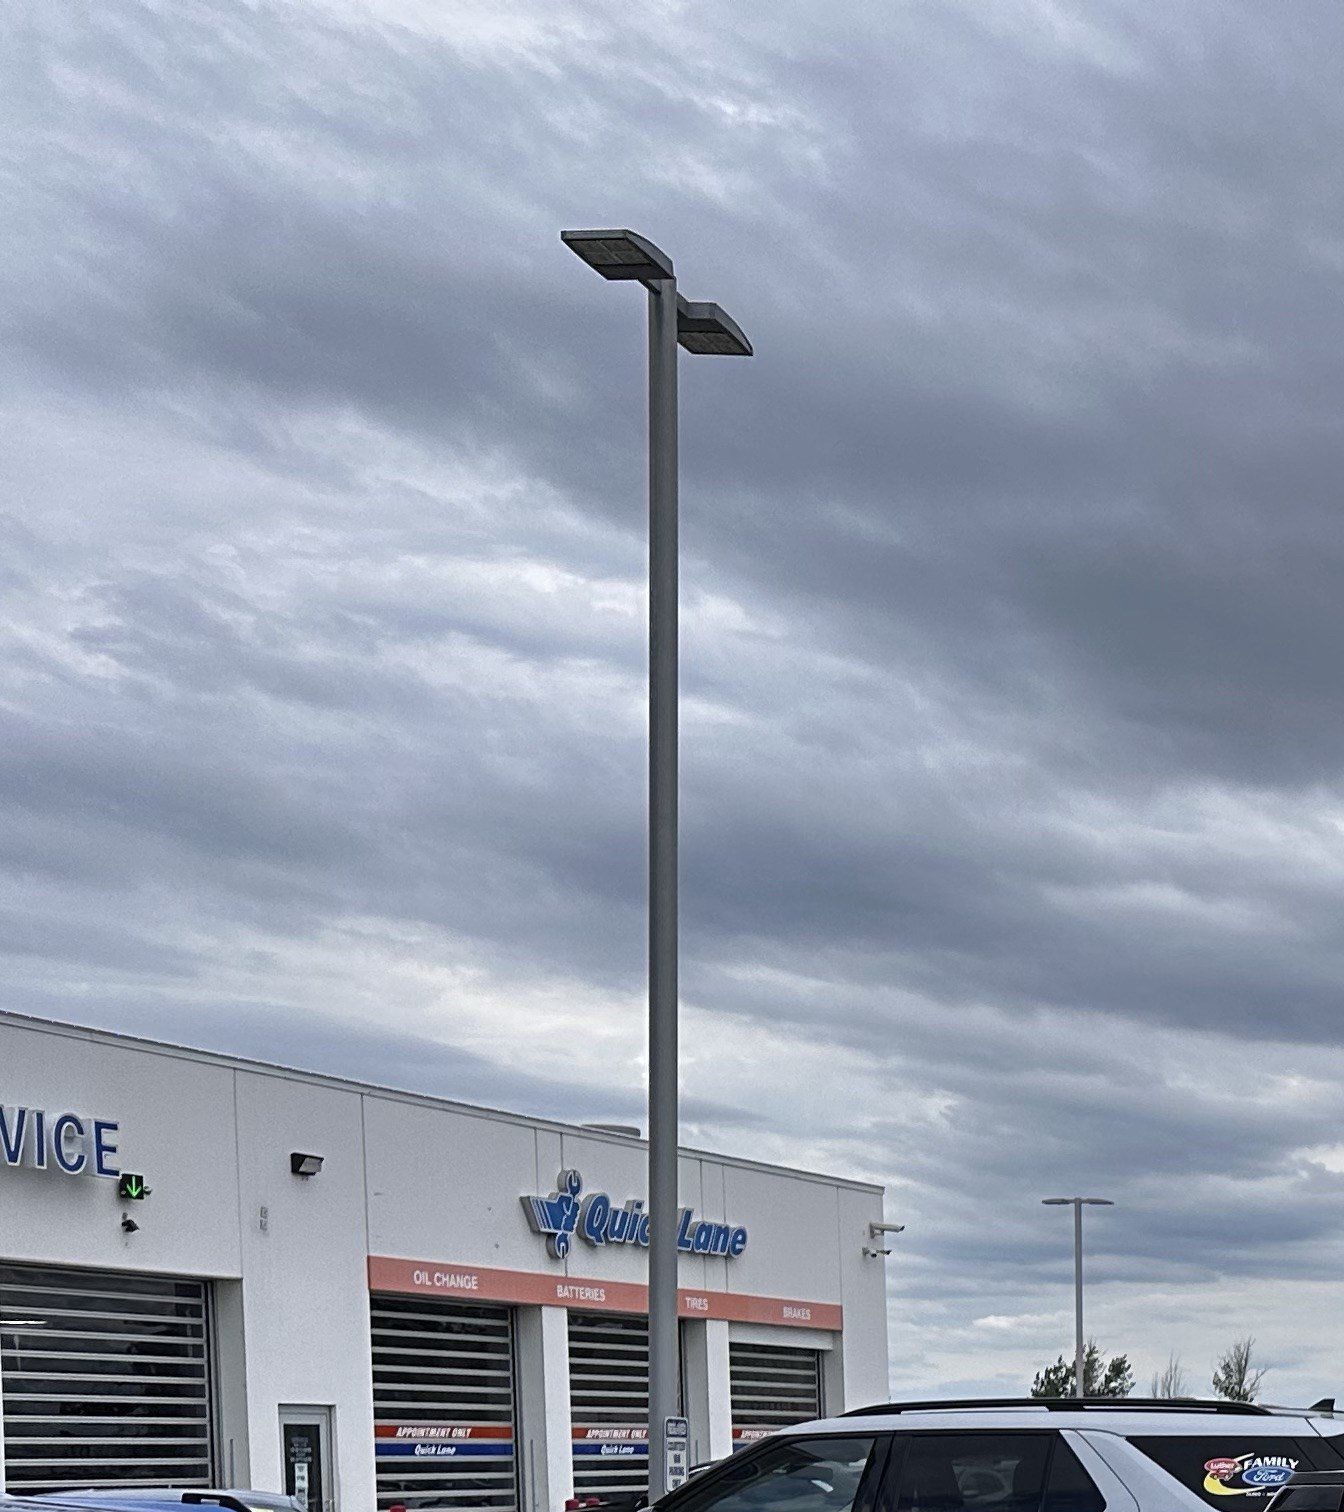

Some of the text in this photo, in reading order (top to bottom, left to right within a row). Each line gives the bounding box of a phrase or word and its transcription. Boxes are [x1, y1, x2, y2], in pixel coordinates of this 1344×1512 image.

[585, 1194, 747, 1257] Quic Lane
[413, 1270, 479, 1290] OIL CHANGE
[556, 1284, 606, 1302] BATTERIES
[685, 1297, 709, 1311] TIRES
[782, 1306, 812, 1321] BRAKES
[395, 1427, 472, 1438] APPOINTMENT ONLY
[585, 1429, 631, 1439] APPOINTMENT
[414, 1444, 456, 1456] Quick Lane
[1243, 1456, 1299, 1471] FAMILY
[1253, 1469, 1285, 1482] Ford
